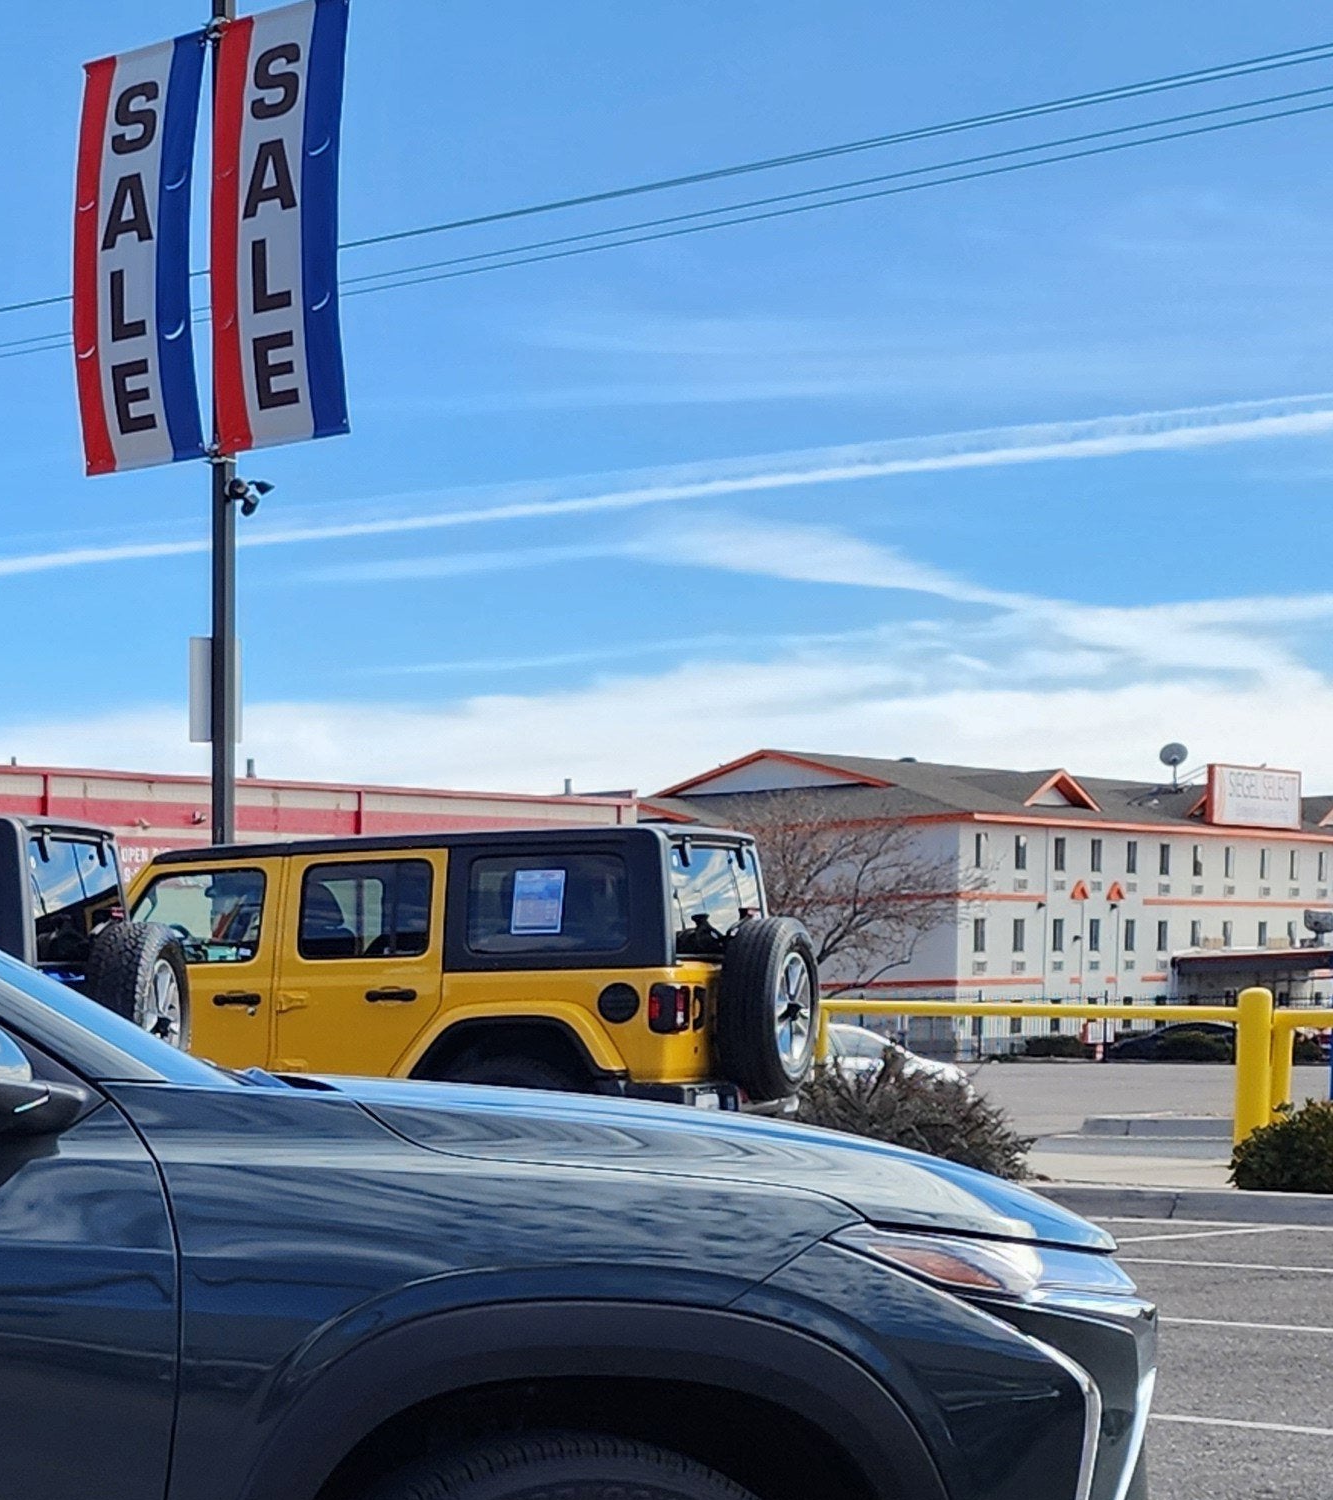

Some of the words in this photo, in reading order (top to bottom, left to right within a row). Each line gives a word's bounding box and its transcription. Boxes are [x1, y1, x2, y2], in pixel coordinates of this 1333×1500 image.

[101, 80, 160, 435] SALE
[242, 42, 302, 411] SALE
[121, 846, 149, 863] OPEN
